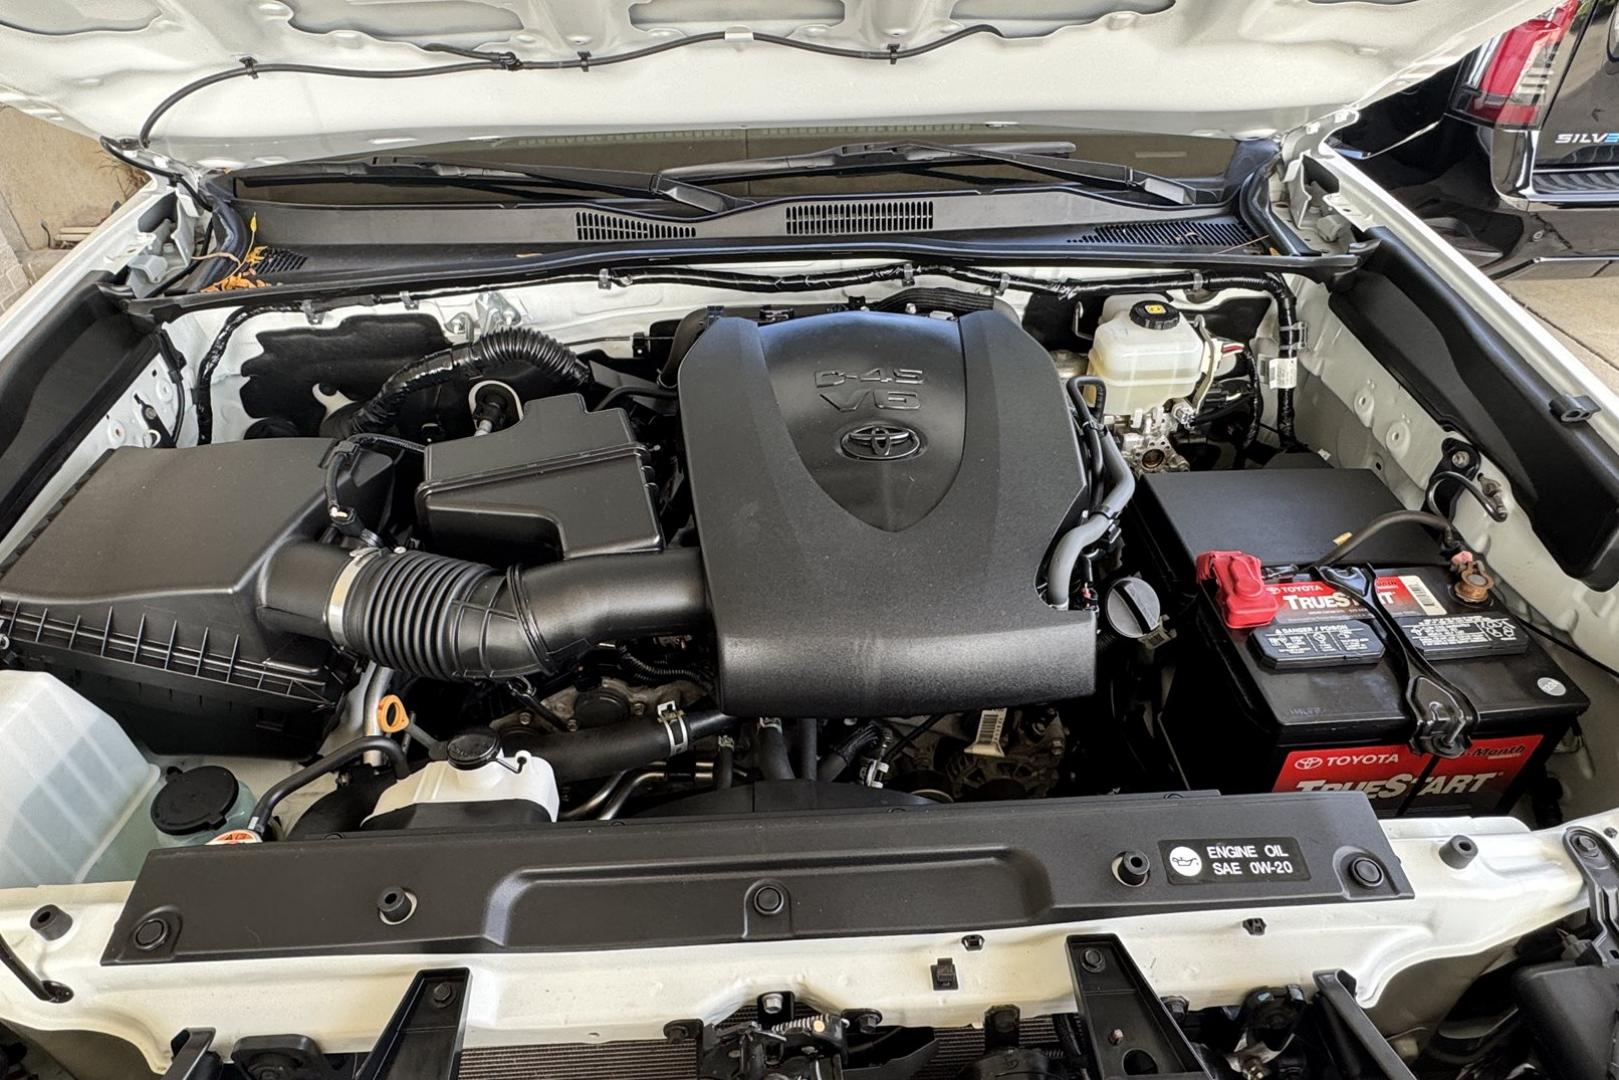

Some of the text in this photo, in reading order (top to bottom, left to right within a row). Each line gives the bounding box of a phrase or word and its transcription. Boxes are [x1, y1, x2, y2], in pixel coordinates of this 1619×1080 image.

[819, 388, 921, 413] V6
[1281, 584, 1324, 592] TOYOTA
[1326, 753, 1400, 767] TOYOTA
[1206, 844, 1289, 859] ENGINE OIL
[1211, 861, 1294, 875] SAE 0W-20
